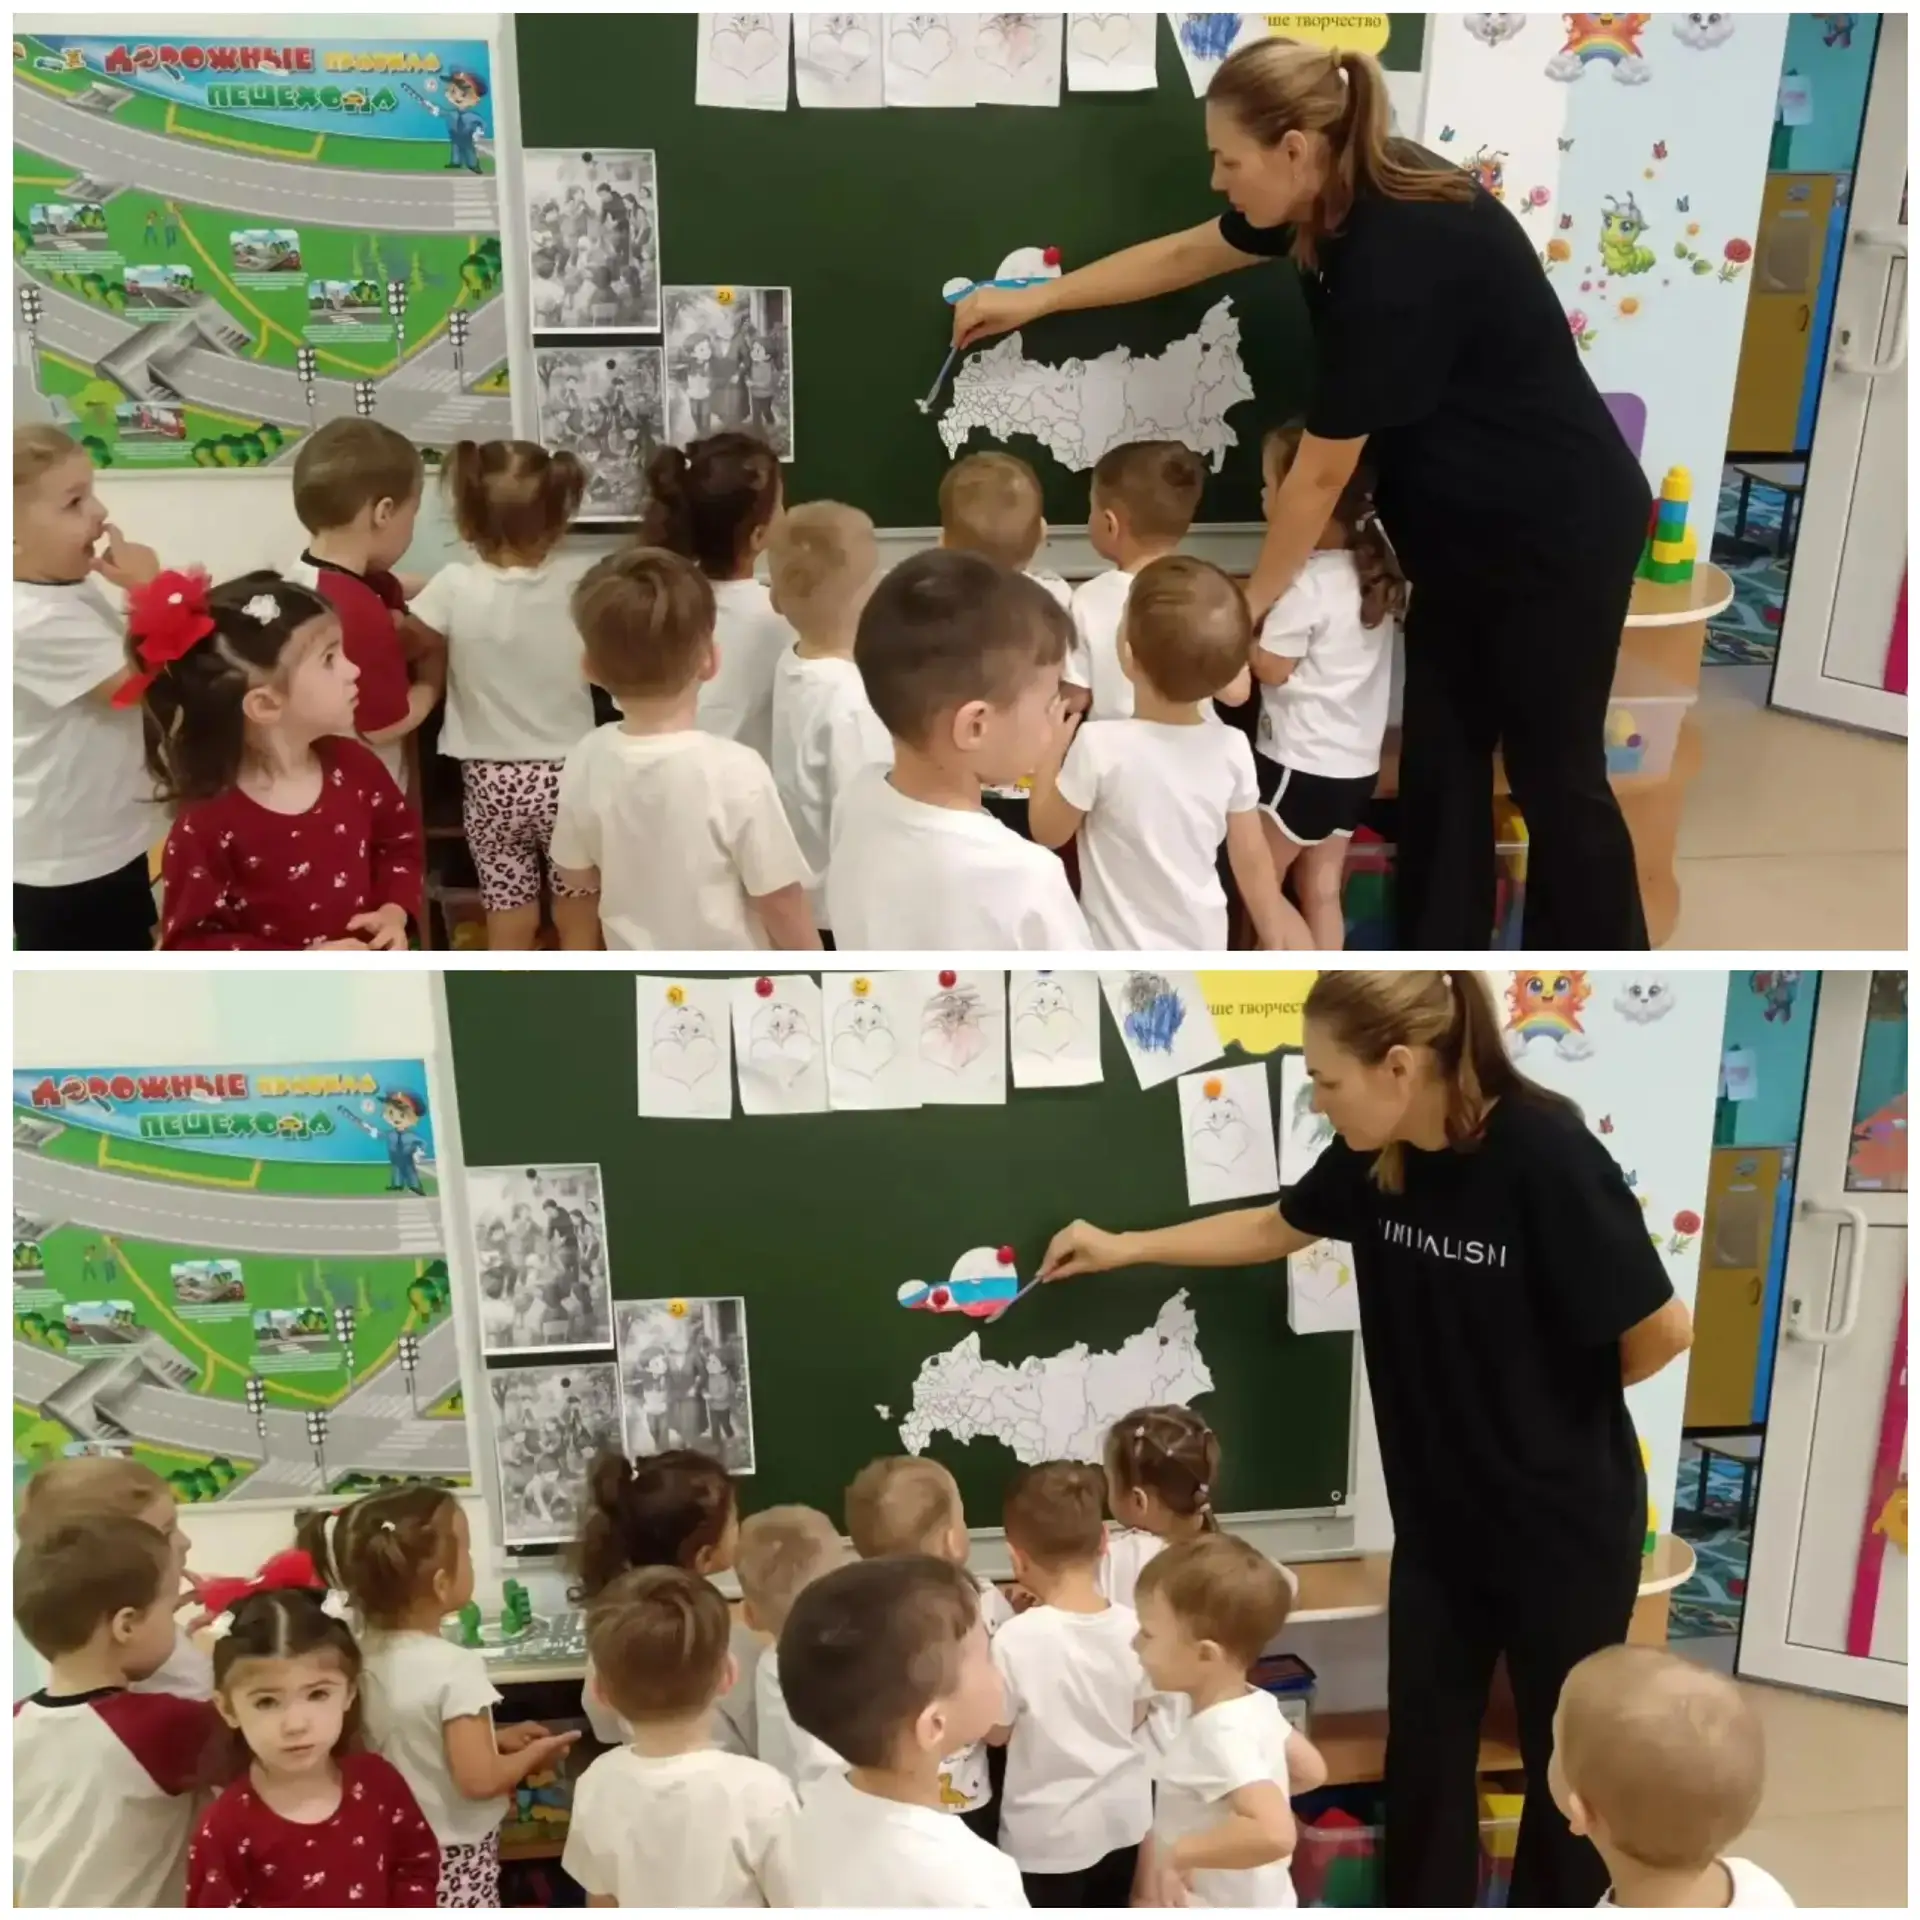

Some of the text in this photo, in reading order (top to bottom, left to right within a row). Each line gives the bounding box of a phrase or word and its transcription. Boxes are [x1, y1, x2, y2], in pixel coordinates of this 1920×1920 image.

[1263, 15, 1382, 31] ше творчество
[1207, 1002, 1234, 1015] ше
[1378, 1218, 1506, 1268] INIALISM
